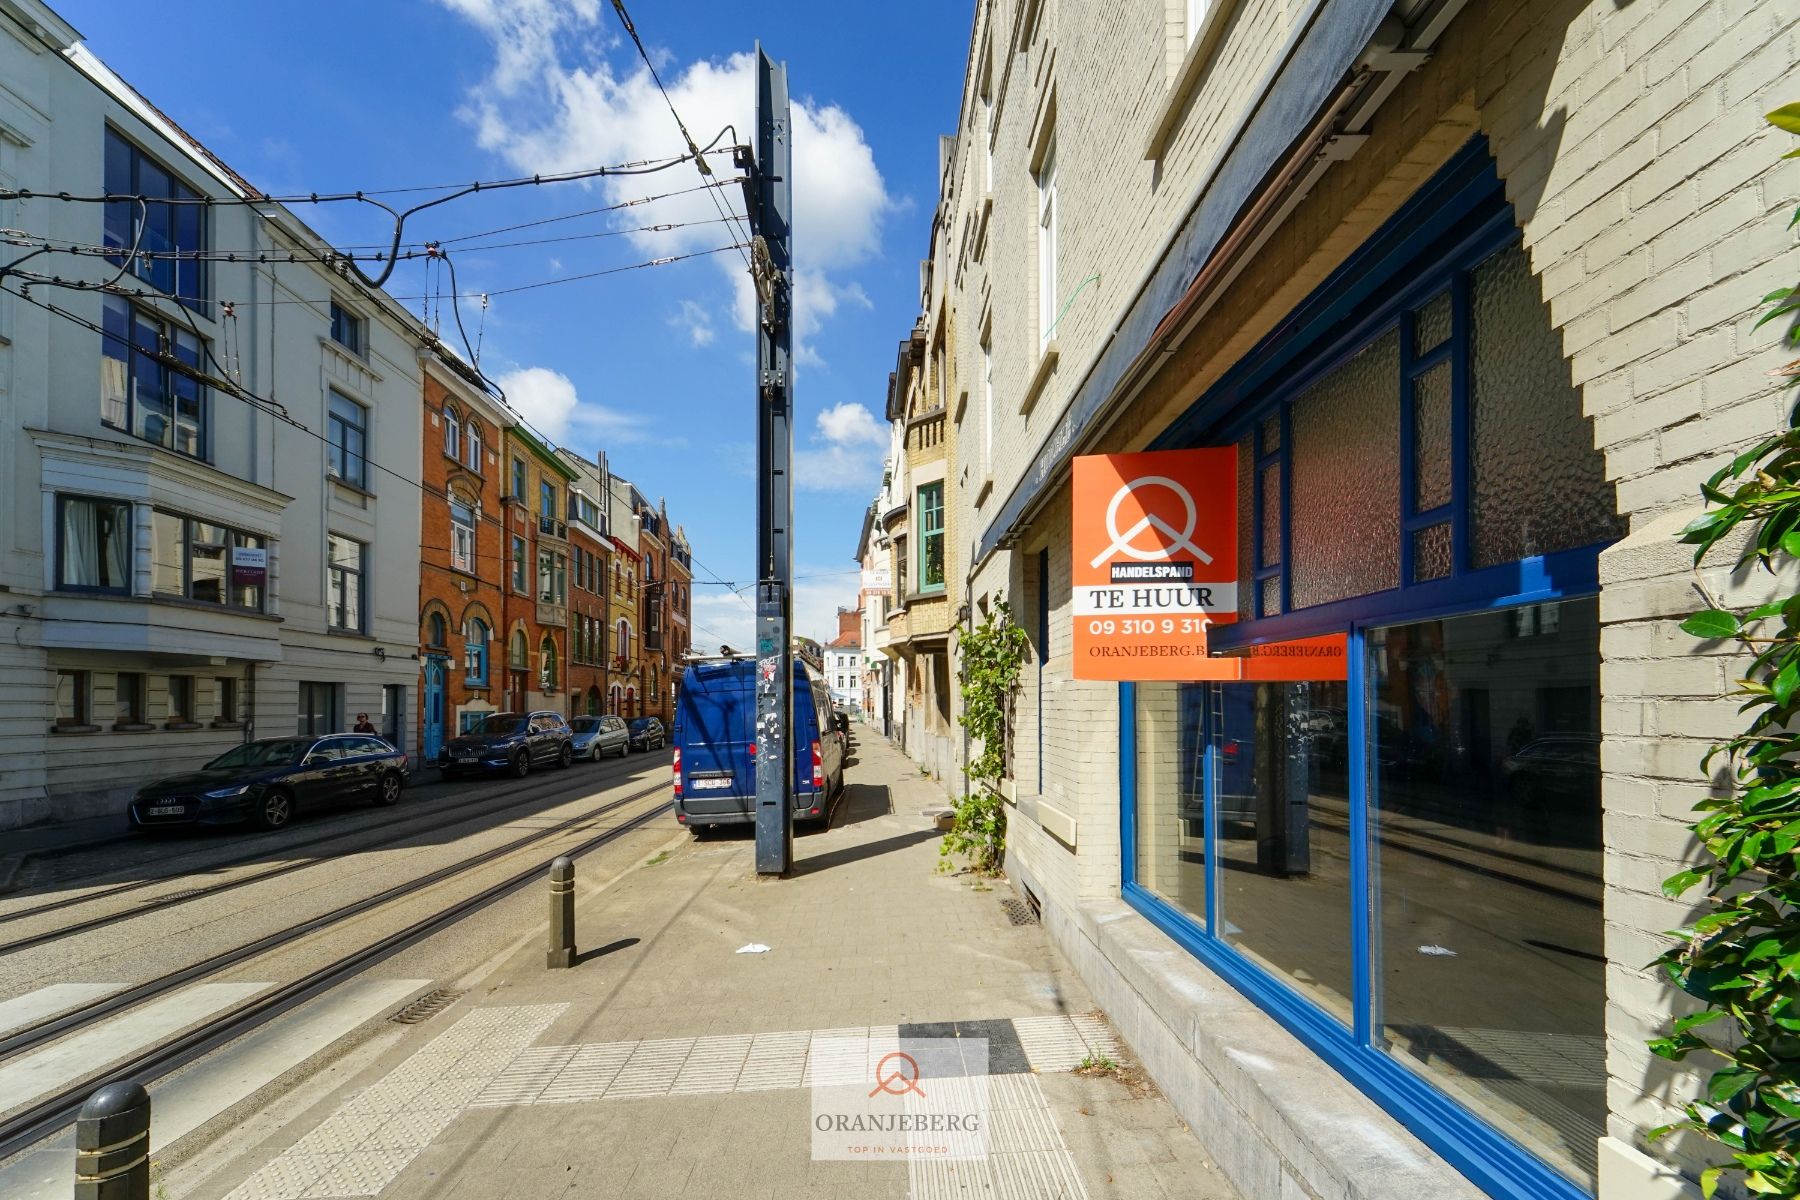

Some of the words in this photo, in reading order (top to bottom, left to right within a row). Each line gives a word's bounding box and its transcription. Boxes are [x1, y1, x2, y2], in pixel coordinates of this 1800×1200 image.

[1111, 566, 1193, 579] HANDELSPAND
[1089, 589, 1124, 609] TE
[1132, 587, 1215, 608] HUUR
[1089, 620, 1115, 635] 09
[1121, 619, 1155, 635] 310
[1161, 619, 1174, 635] 9
[1089, 645, 1205, 658] ORANJEBERG.B
